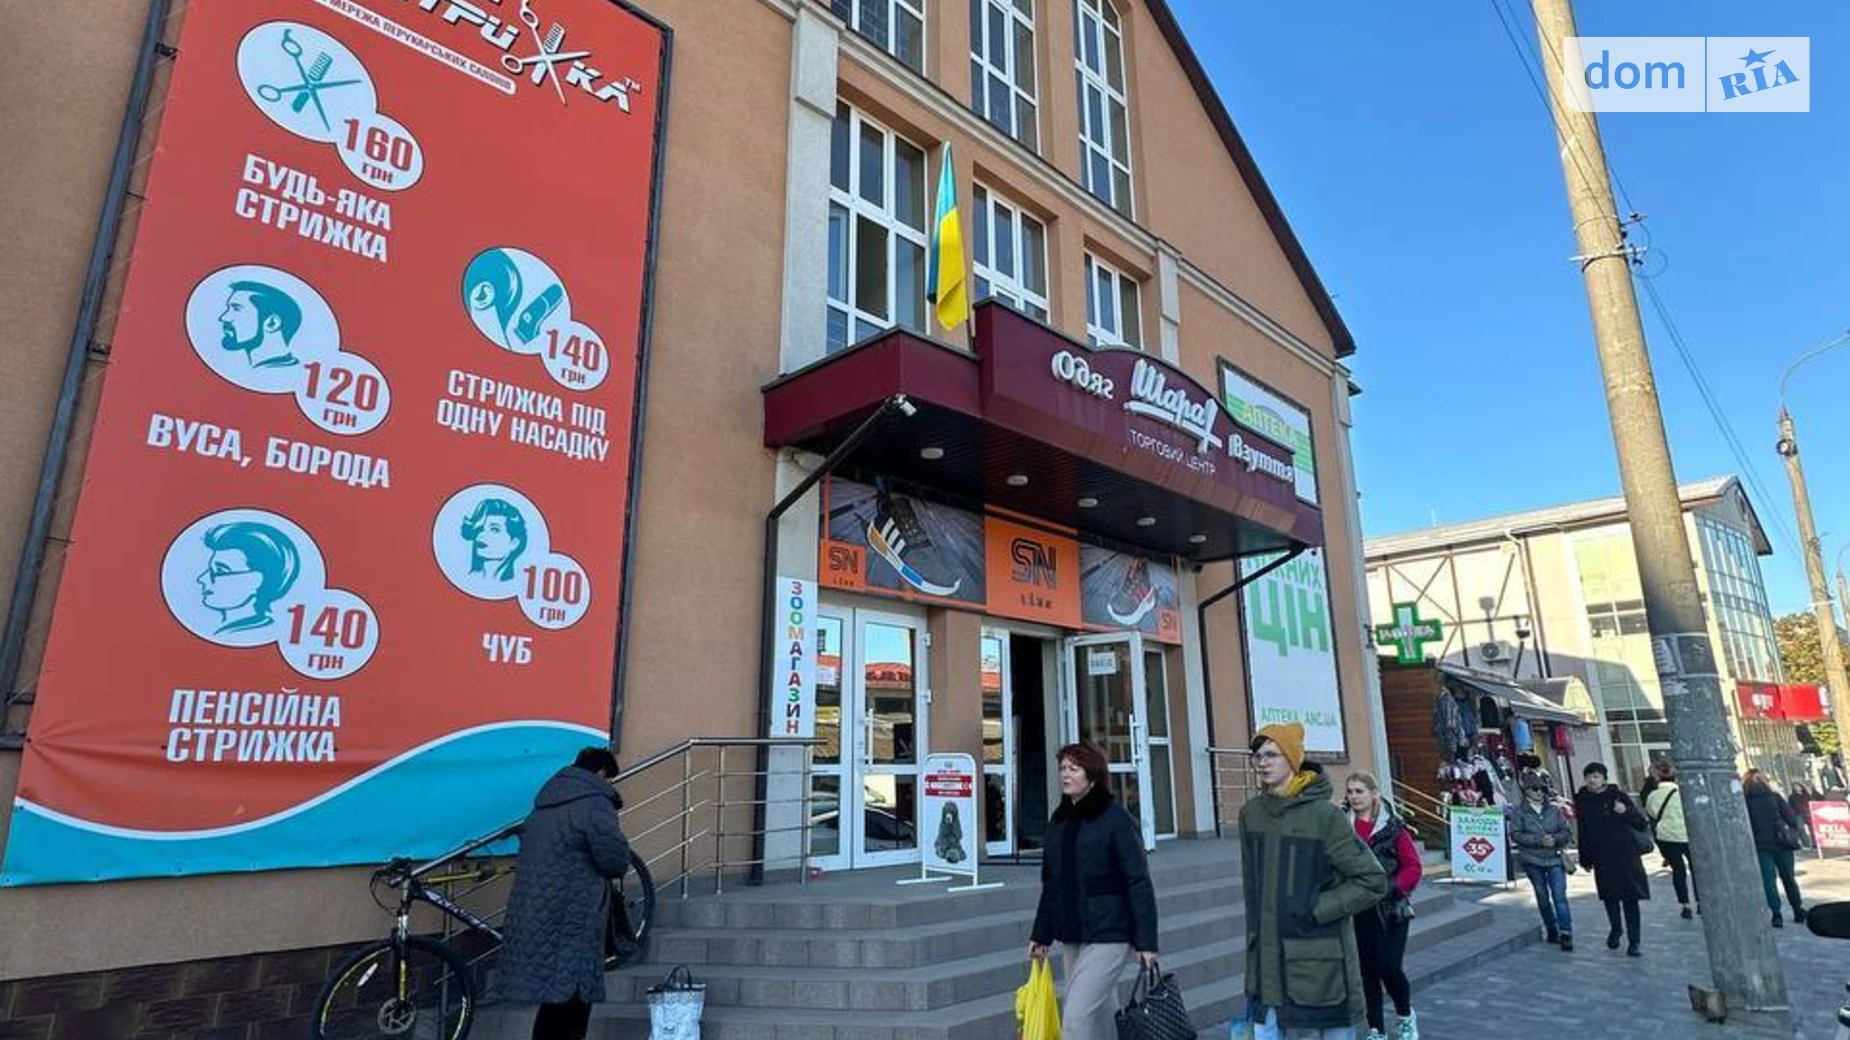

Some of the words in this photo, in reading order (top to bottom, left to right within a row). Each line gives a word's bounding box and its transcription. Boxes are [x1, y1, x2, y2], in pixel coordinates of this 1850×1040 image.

[344, 118, 414, 172] 160
[243, 153, 392, 230] БУДЬ-ЯКА
[361, 162, 394, 184] грн
[235, 187, 388, 263] СТРИЖКА
[545, 328, 601, 371] 140
[304, 361, 380, 413] 120
[561, 367, 586, 385] грн
[322, 407, 358, 428] грн
[447, 369, 563, 423] СТРИЖКА
[571, 406, 607, 436] ПІД
[146, 413, 254, 468] ВУСА,
[265, 437, 391, 489] БОРОДА
[436, 399, 501, 436] ОДНУ
[509, 419, 609, 463] НАСАДКУ
[1130, 429, 1184, 462] ТОРГОВИЙ
[1228, 433, 1294, 482] Взуття
[828, 546, 859, 575] SN
[1011, 537, 1057, 591] SN
[523, 565, 582, 605] 100
[286, 604, 368, 650] 140
[539, 605, 566, 622] грн
[1249, 579, 1329, 657] ЦІН
[308, 652, 343, 671] грн
[481, 634, 533, 664] ЧУБ
[786, 581, 804, 734] ЗООМАГАЗИН
[169, 687, 341, 728] ПЕНСІЙНА
[166, 729, 336, 763] СТРИЖКА
